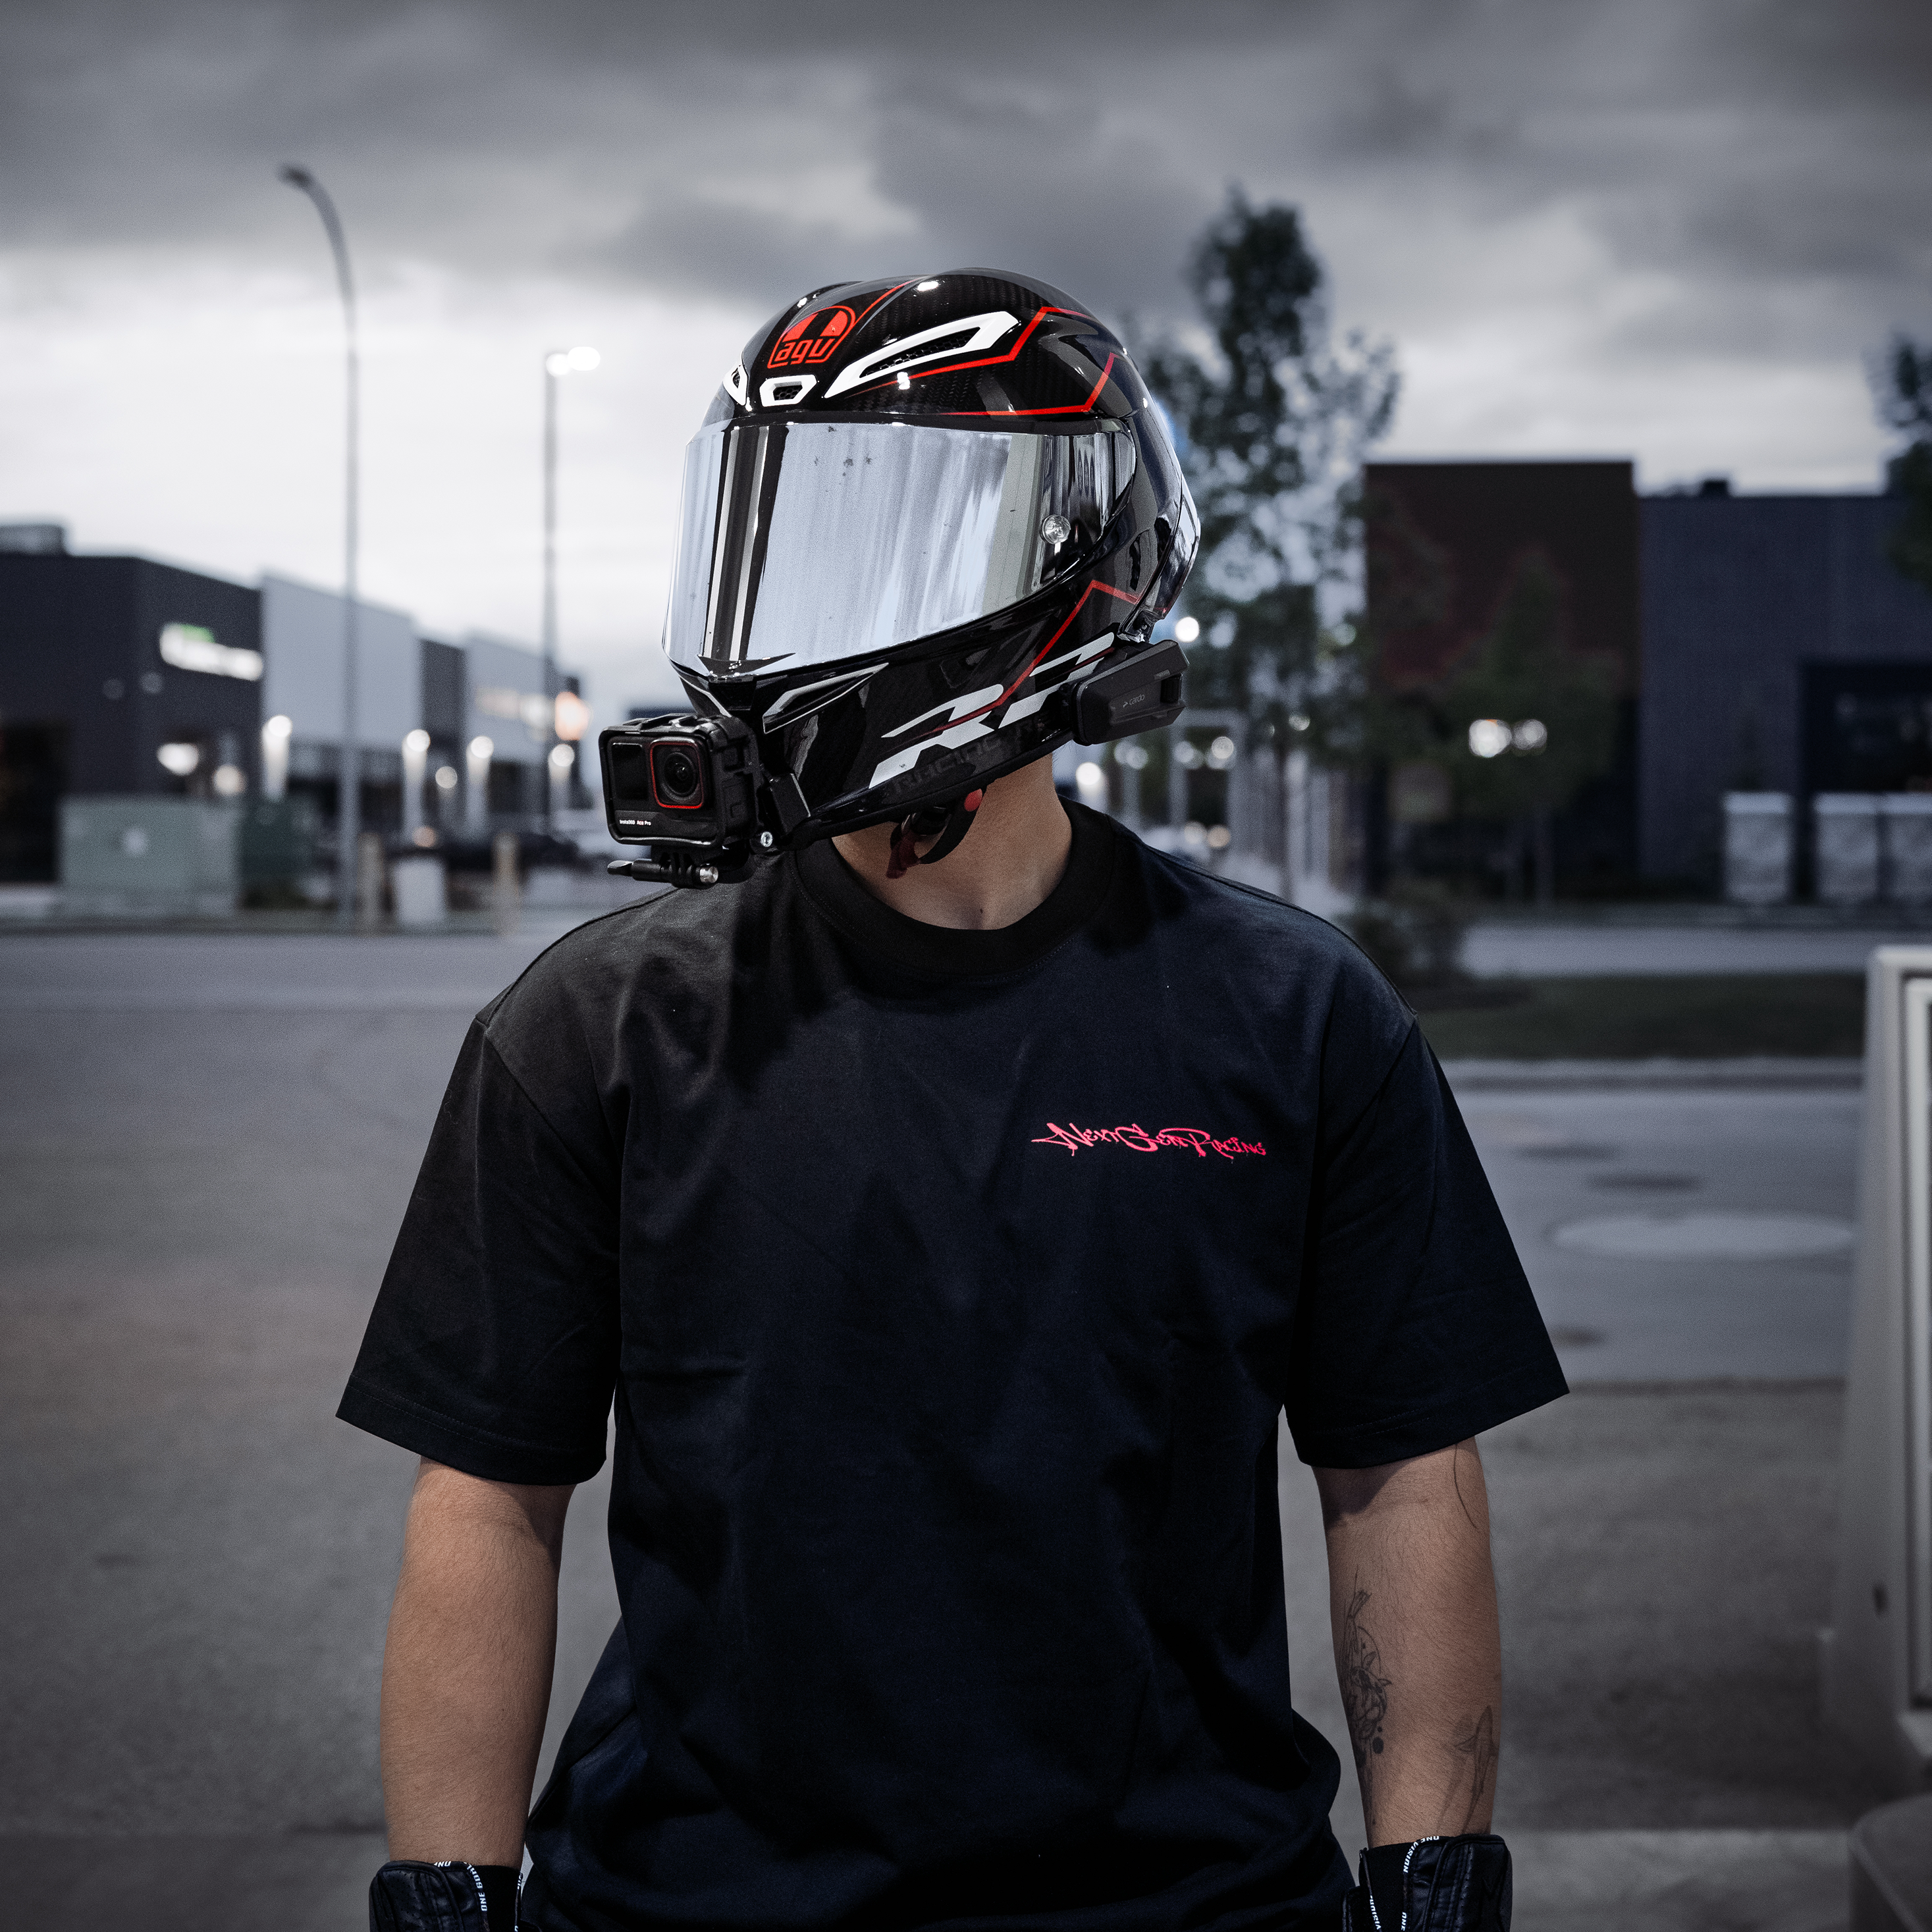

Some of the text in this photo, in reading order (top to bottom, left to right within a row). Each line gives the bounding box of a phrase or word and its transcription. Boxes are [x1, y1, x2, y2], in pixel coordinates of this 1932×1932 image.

[1129, 693, 1145, 705] cardo
[1403, 1841, 1419, 1873] VISION
[478, 1892, 488, 1912] ONE
